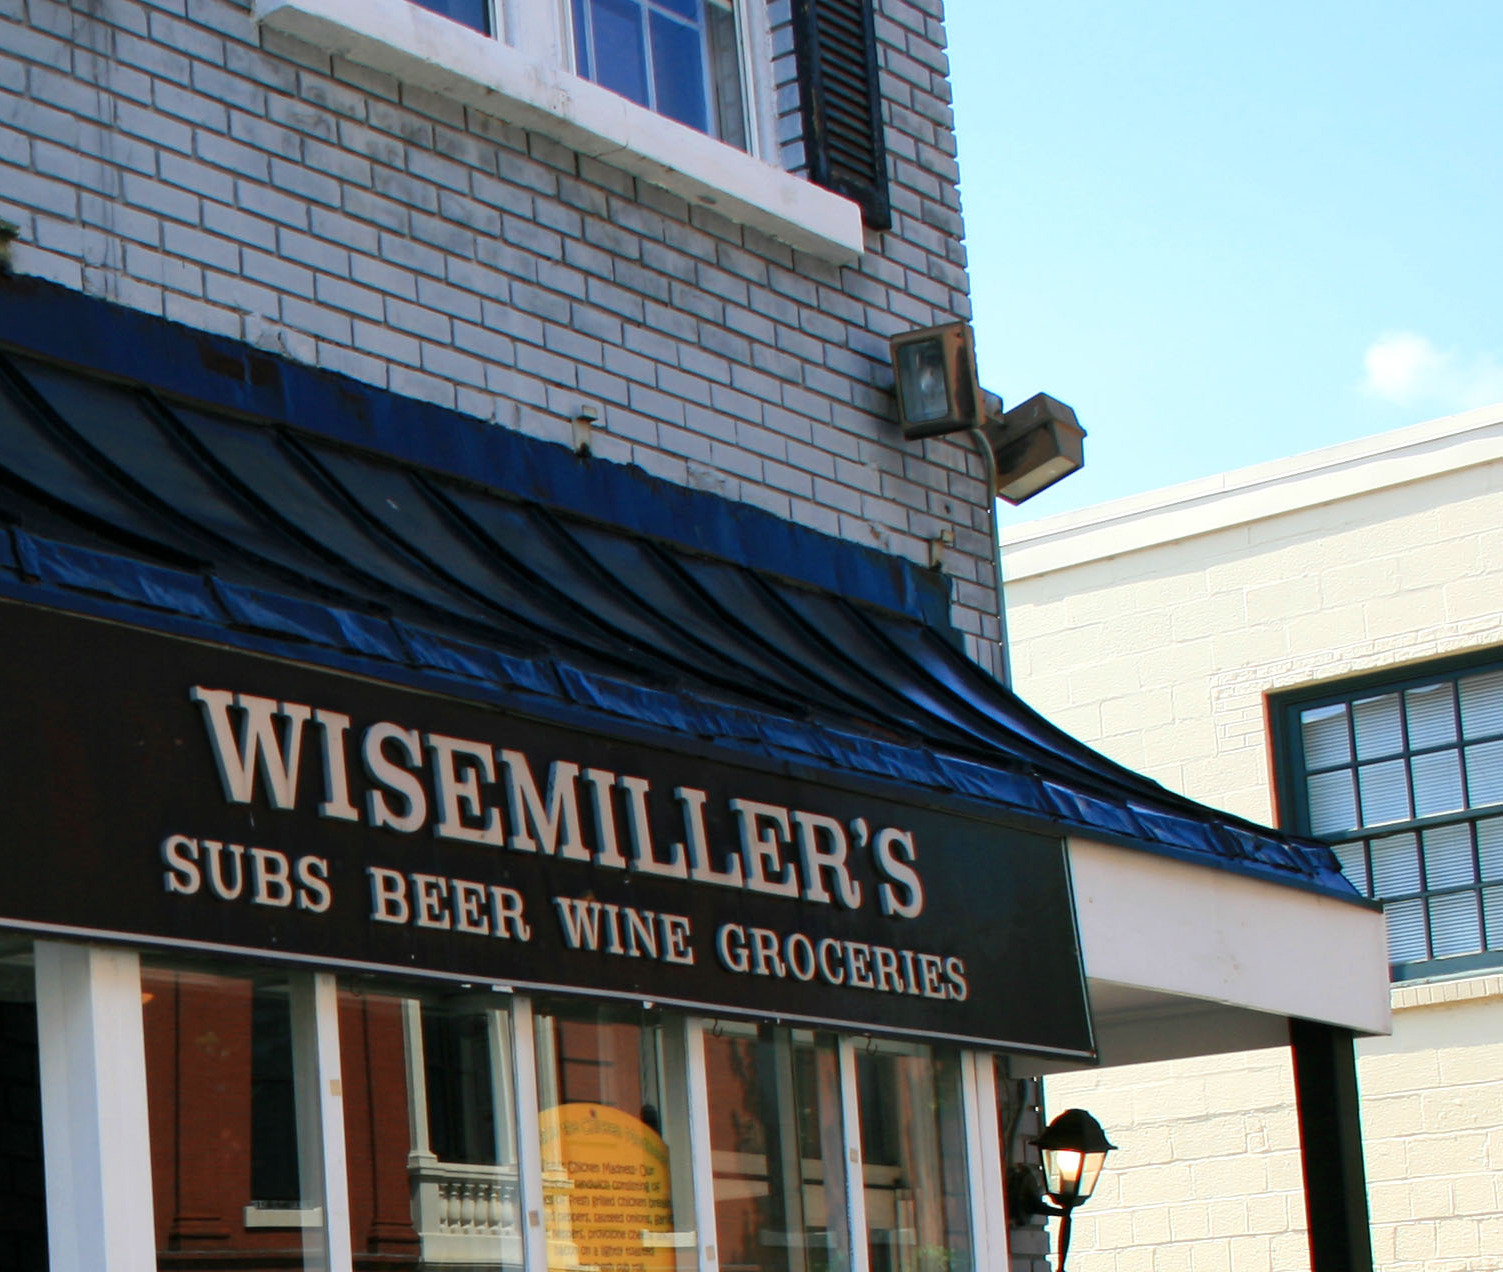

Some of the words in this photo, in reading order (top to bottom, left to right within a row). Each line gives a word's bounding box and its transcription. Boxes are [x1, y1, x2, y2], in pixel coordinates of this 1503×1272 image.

[189, 685, 926, 919] WISEMILLER'S
[160, 834, 332, 914] SUBS
[366, 865, 531, 943] BEER
[552, 895, 695, 966] WINE
[716, 922, 968, 1002] GROCERIES
